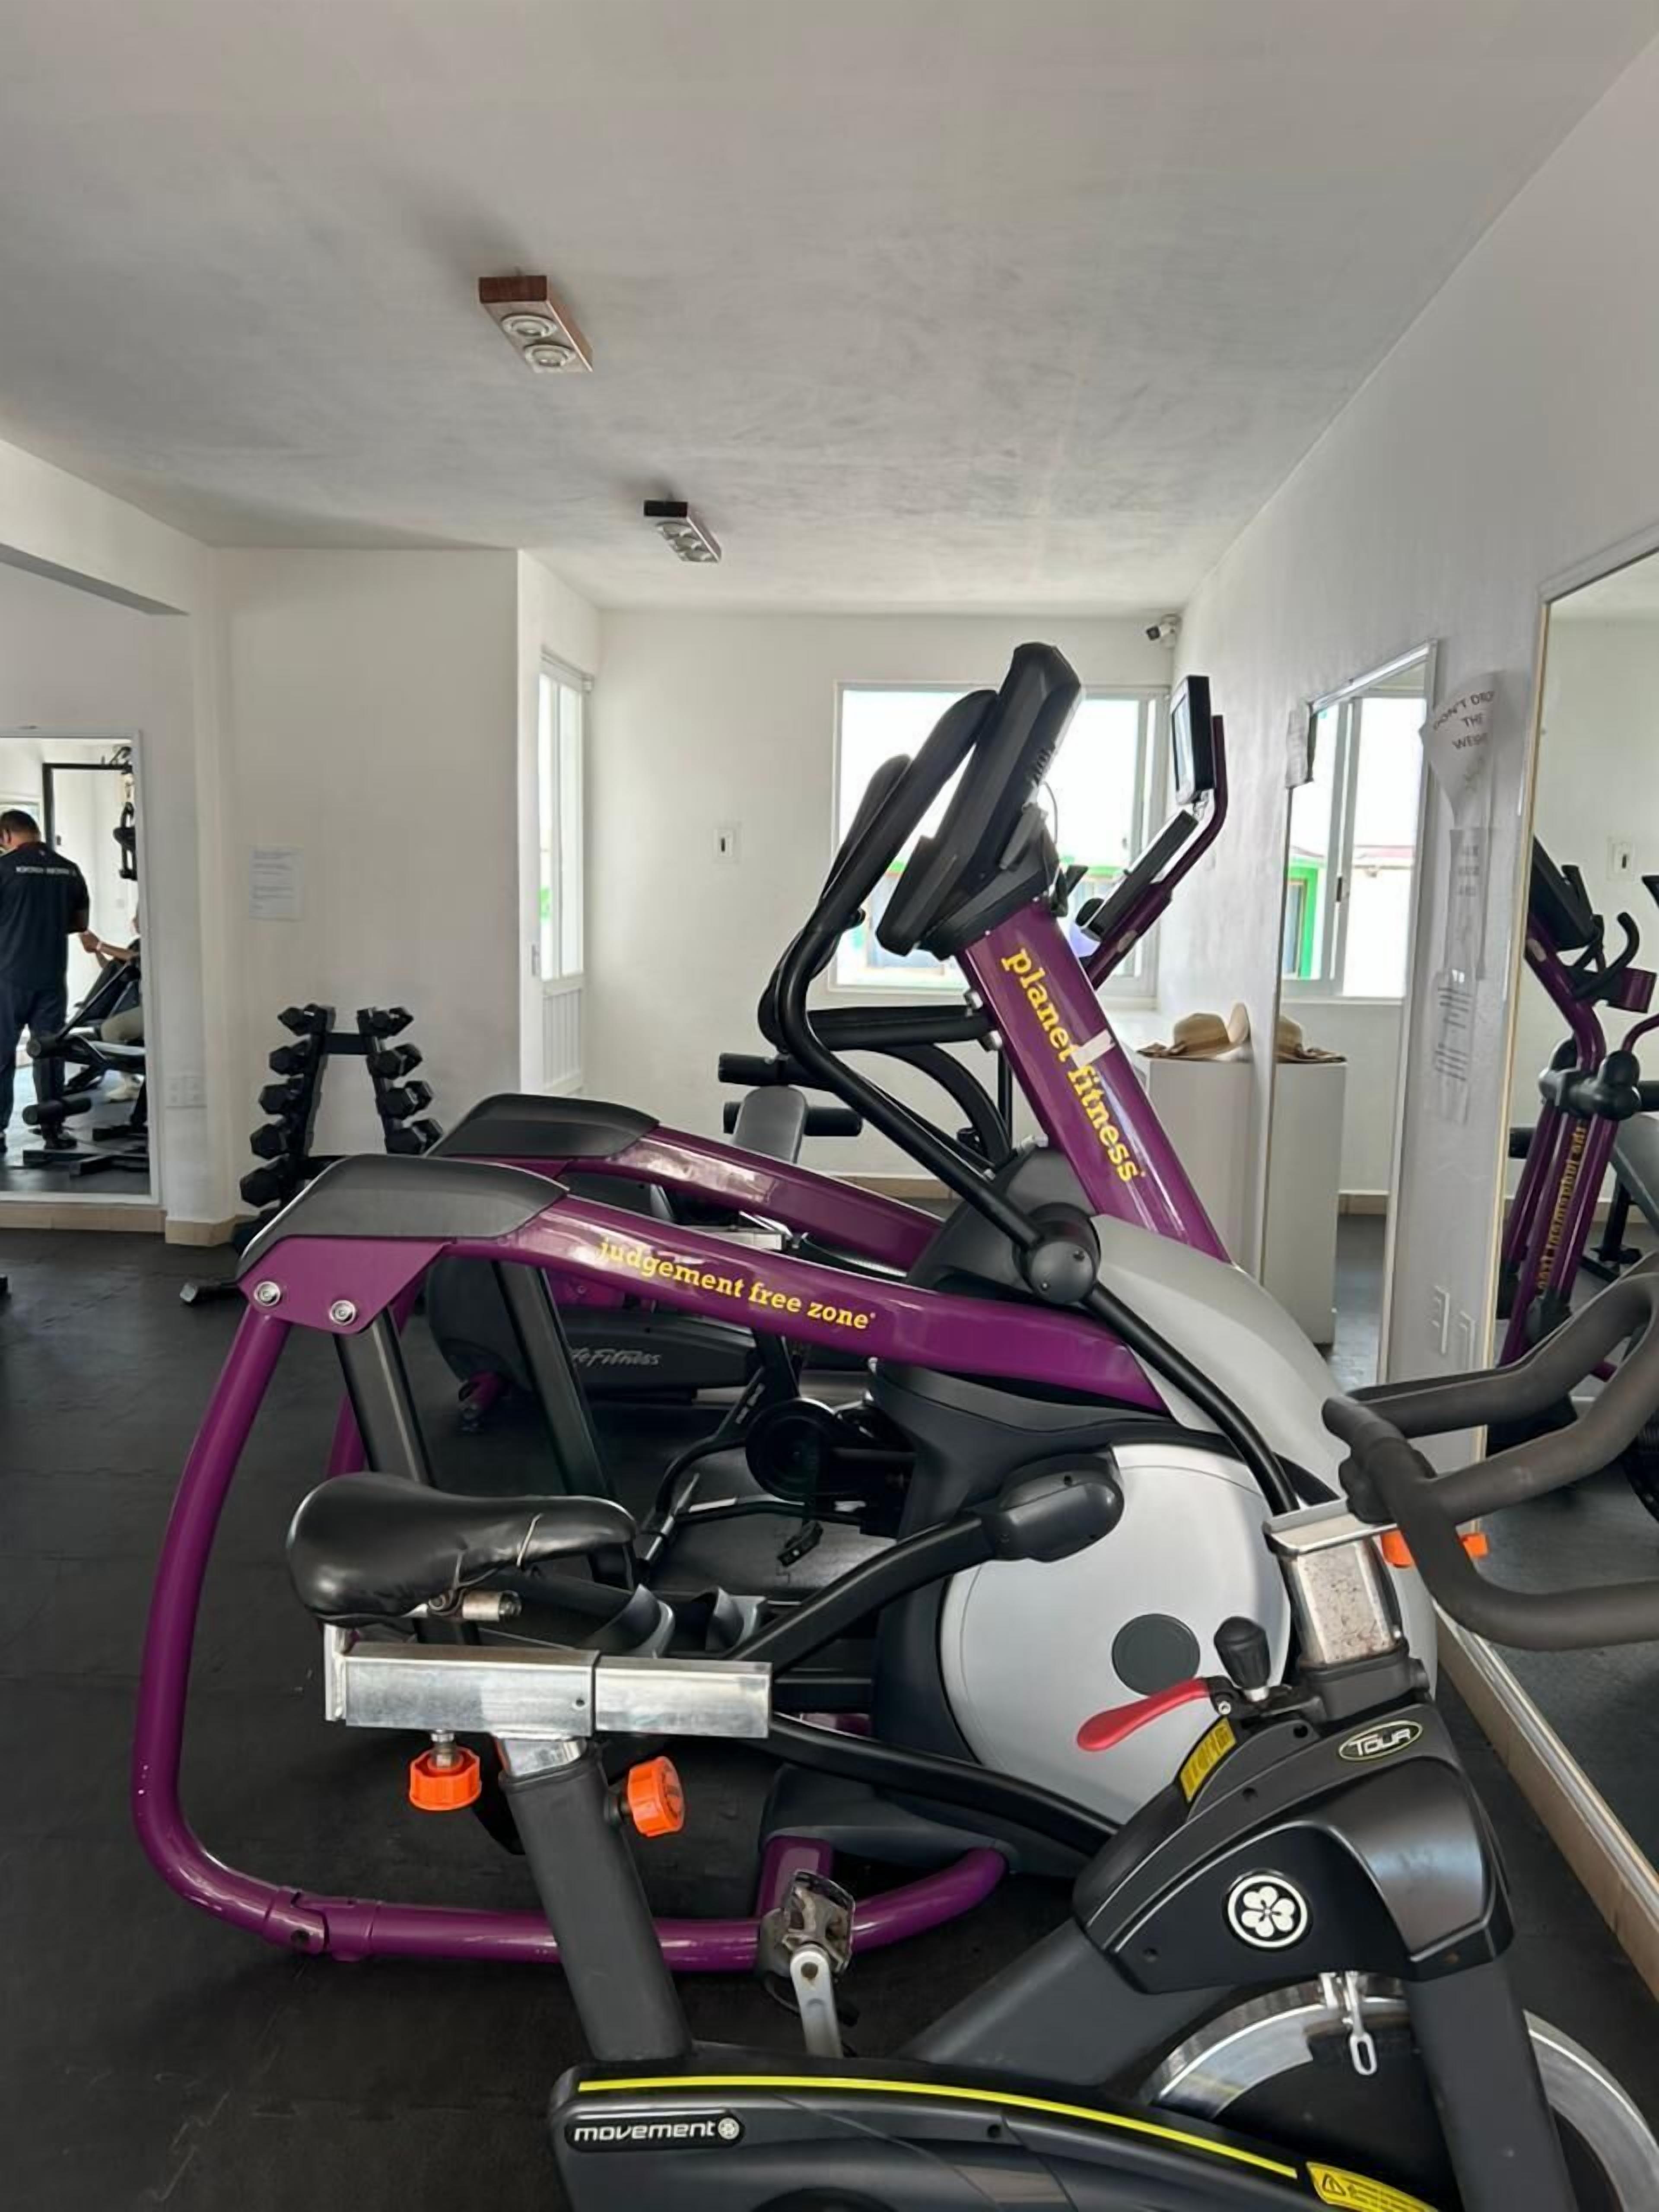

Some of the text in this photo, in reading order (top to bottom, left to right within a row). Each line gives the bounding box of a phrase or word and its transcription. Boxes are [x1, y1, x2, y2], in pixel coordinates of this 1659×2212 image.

[1001, 948, 1138, 1182] planet fitness
[598, 1237, 869, 1330] judgement free zone
[1348, 1728, 1411, 1756] TOUR
[574, 2120, 716, 2142] movement
